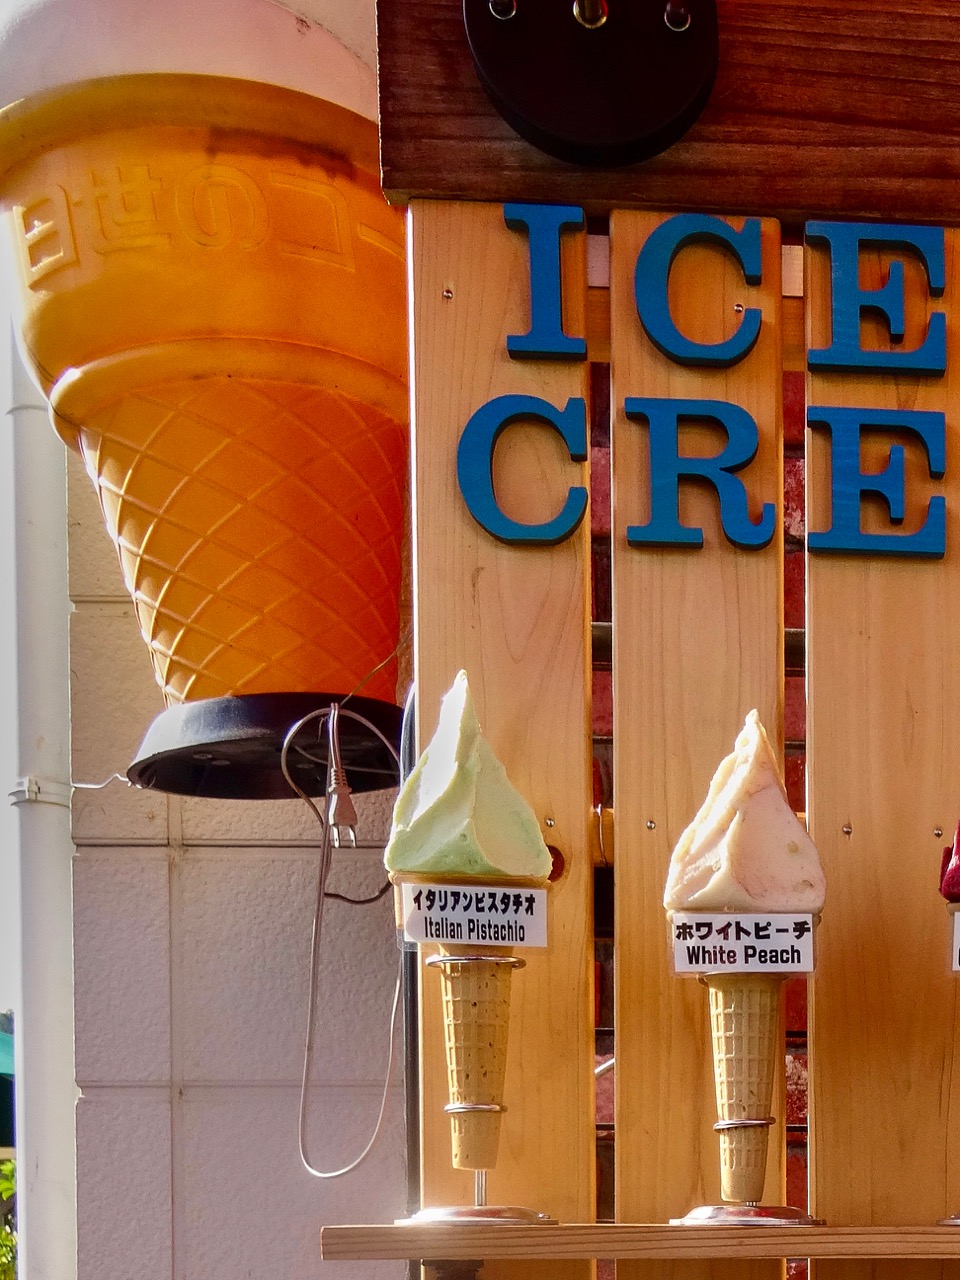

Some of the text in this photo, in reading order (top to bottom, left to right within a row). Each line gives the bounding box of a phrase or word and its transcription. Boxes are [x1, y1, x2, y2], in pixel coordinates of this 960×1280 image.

[504, 203, 947, 376] ICE
[424, 917, 525, 942] Italian Pistachio
[675, 920, 812, 941] ホワイトピーチ
[686, 945, 801, 965] White Peach
